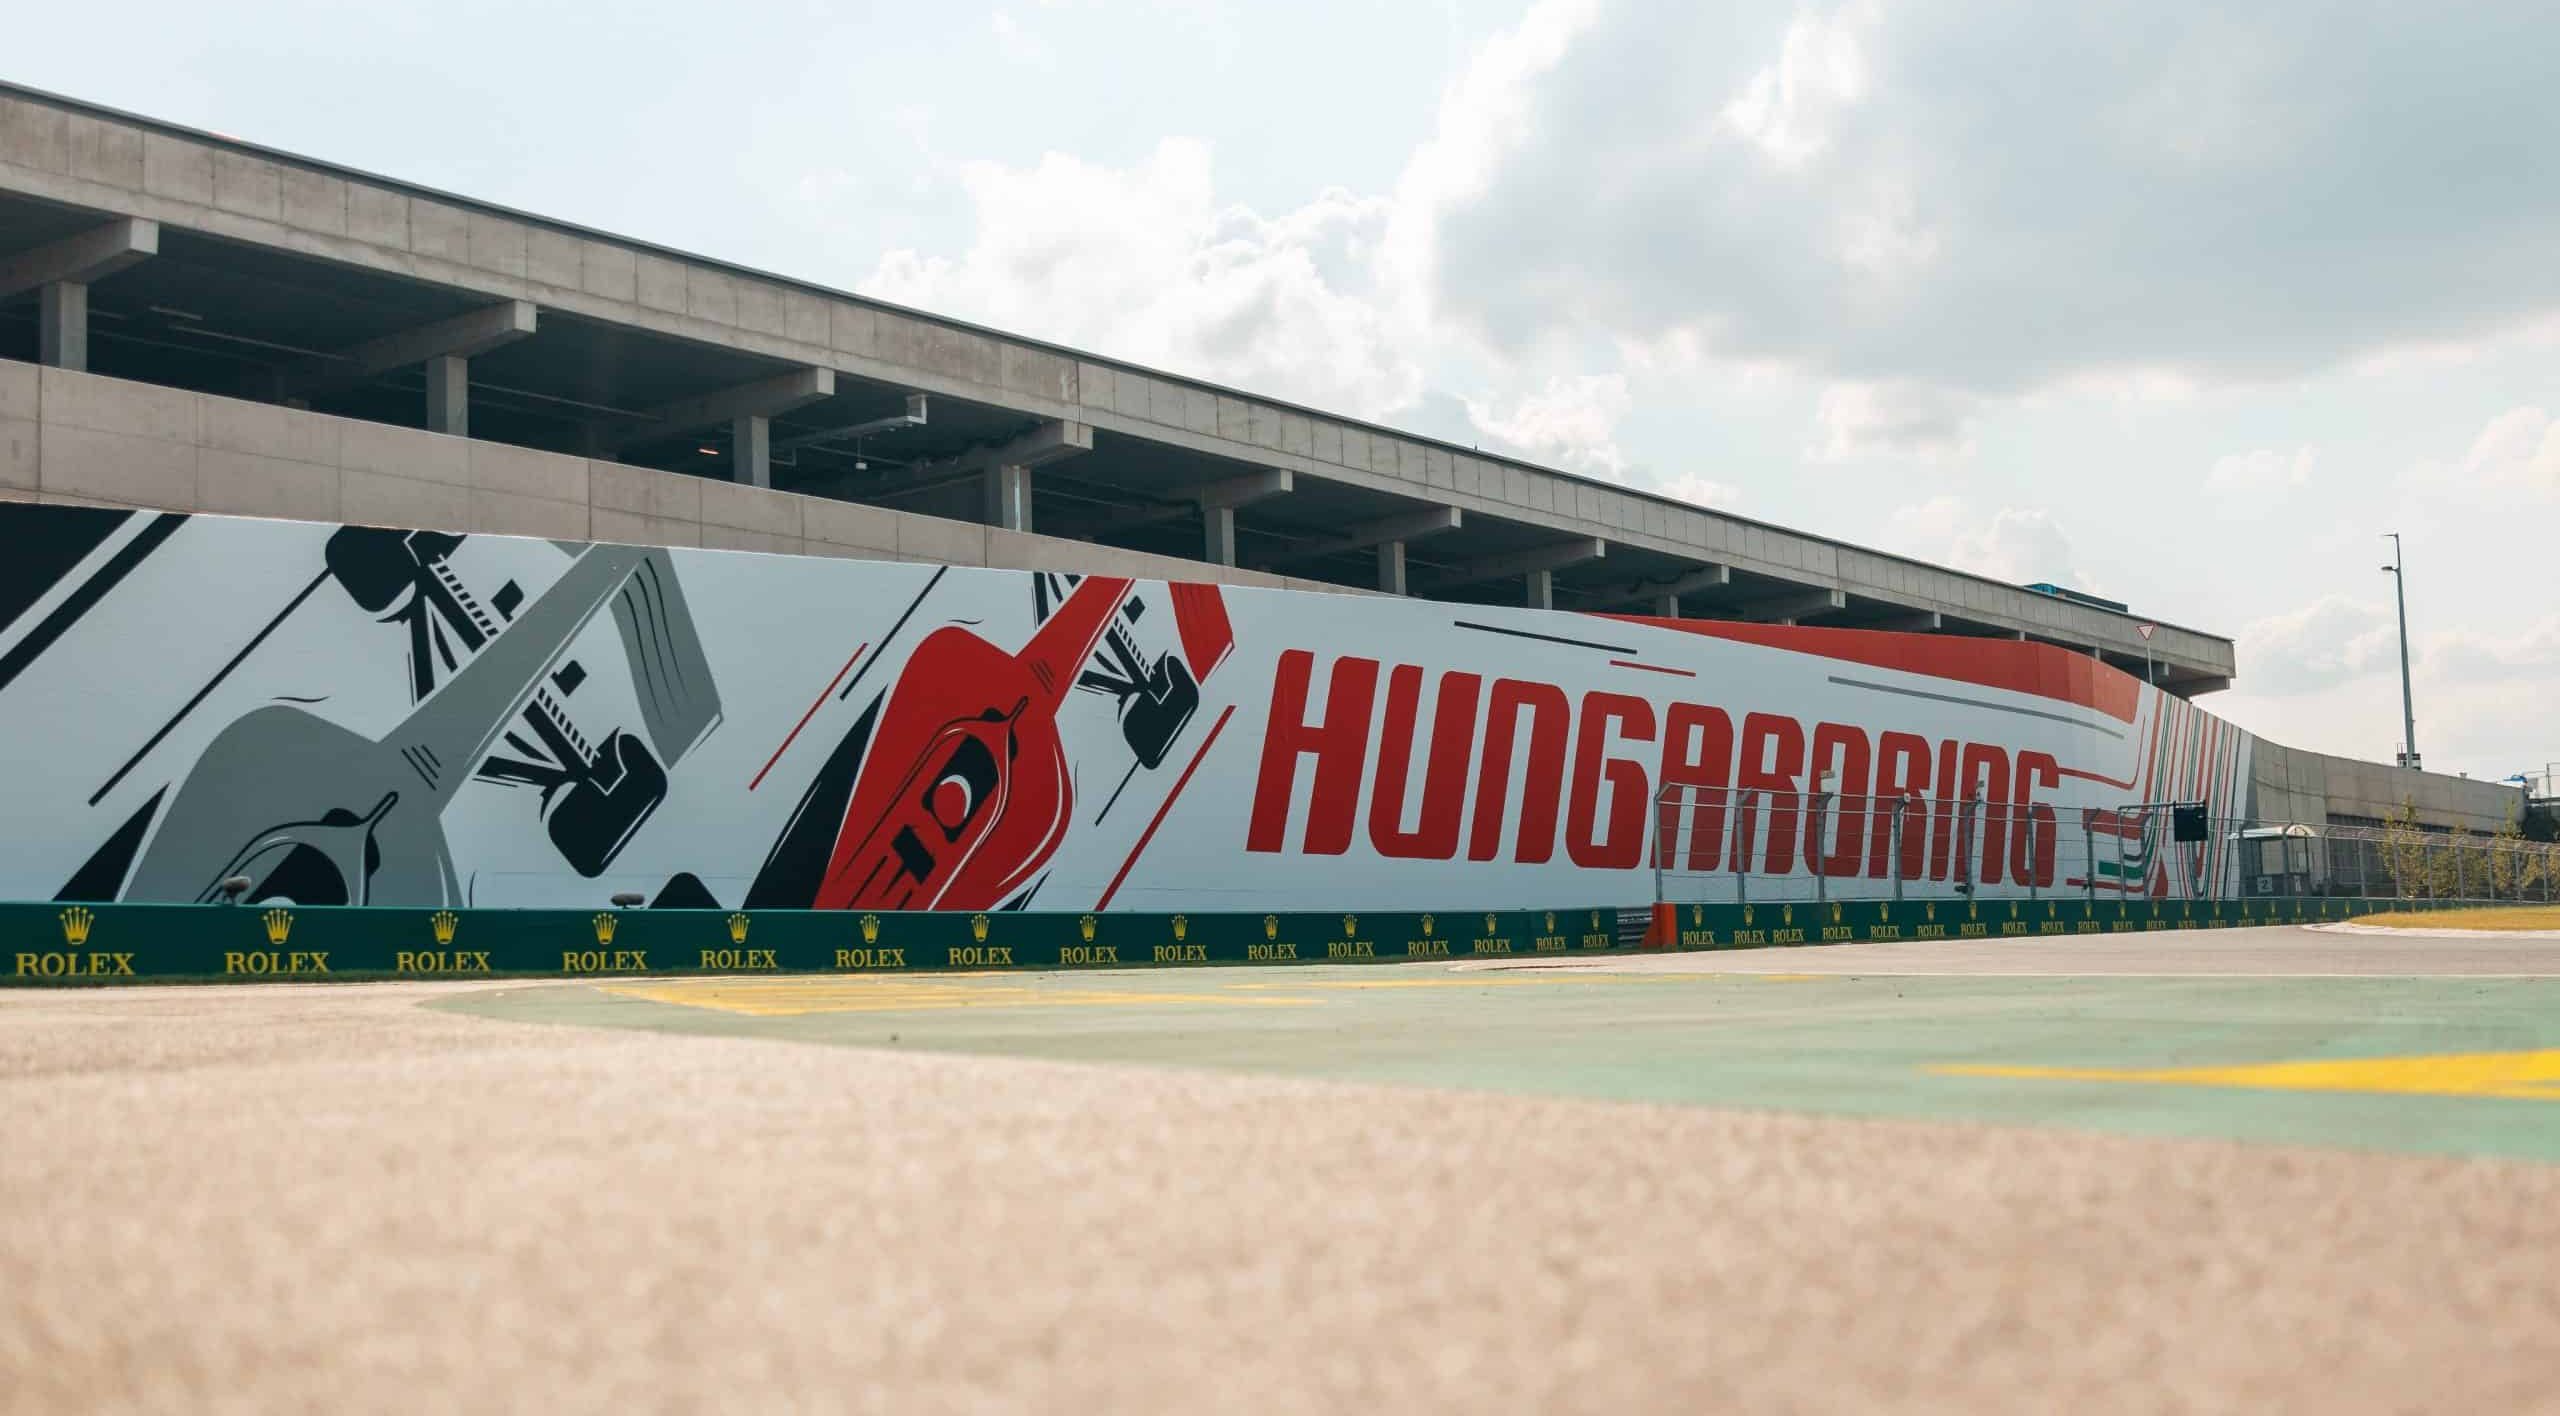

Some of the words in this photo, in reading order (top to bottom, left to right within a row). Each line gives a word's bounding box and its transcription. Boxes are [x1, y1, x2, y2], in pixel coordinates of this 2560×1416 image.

[1246, 648, 2060, 888] HUNGARORING
[1773, 928, 1804, 943] ROLEX
[1823, 926, 1852, 939] ROLEX
[1870, 925, 1900, 939] ROLEX
[1917, 924, 1945, 937] ROLEX
[1961, 921, 1987, 936] ROLEX
[1536, 936, 1566, 951] ROLEX
[1583, 934, 1608, 948] ROLEX
[1683, 931, 1714, 945] ROLEX
[1734, 930, 1767, 944] ROLEX
[1155, 945, 1205, 961] ROLEX
[1249, 944, 1295, 959] ROLEX
[1329, 943, 1374, 957] ROLEX
[1407, 941, 1449, 956] ROLEX
[1474, 939, 1511, 952] ROLEX
[563, 951, 647, 972] ROLEX
[701, 950, 776, 969] ROLEX
[836, 949, 904, 967] ROLEX
[950, 948, 1012, 965] ROLEX
[1061, 947, 1117, 963] ROLEX
[16, 952, 135, 976] ROLEX
[225, 952, 329, 974] ROLEX
[396, 952, 491, 974] ROLEX
